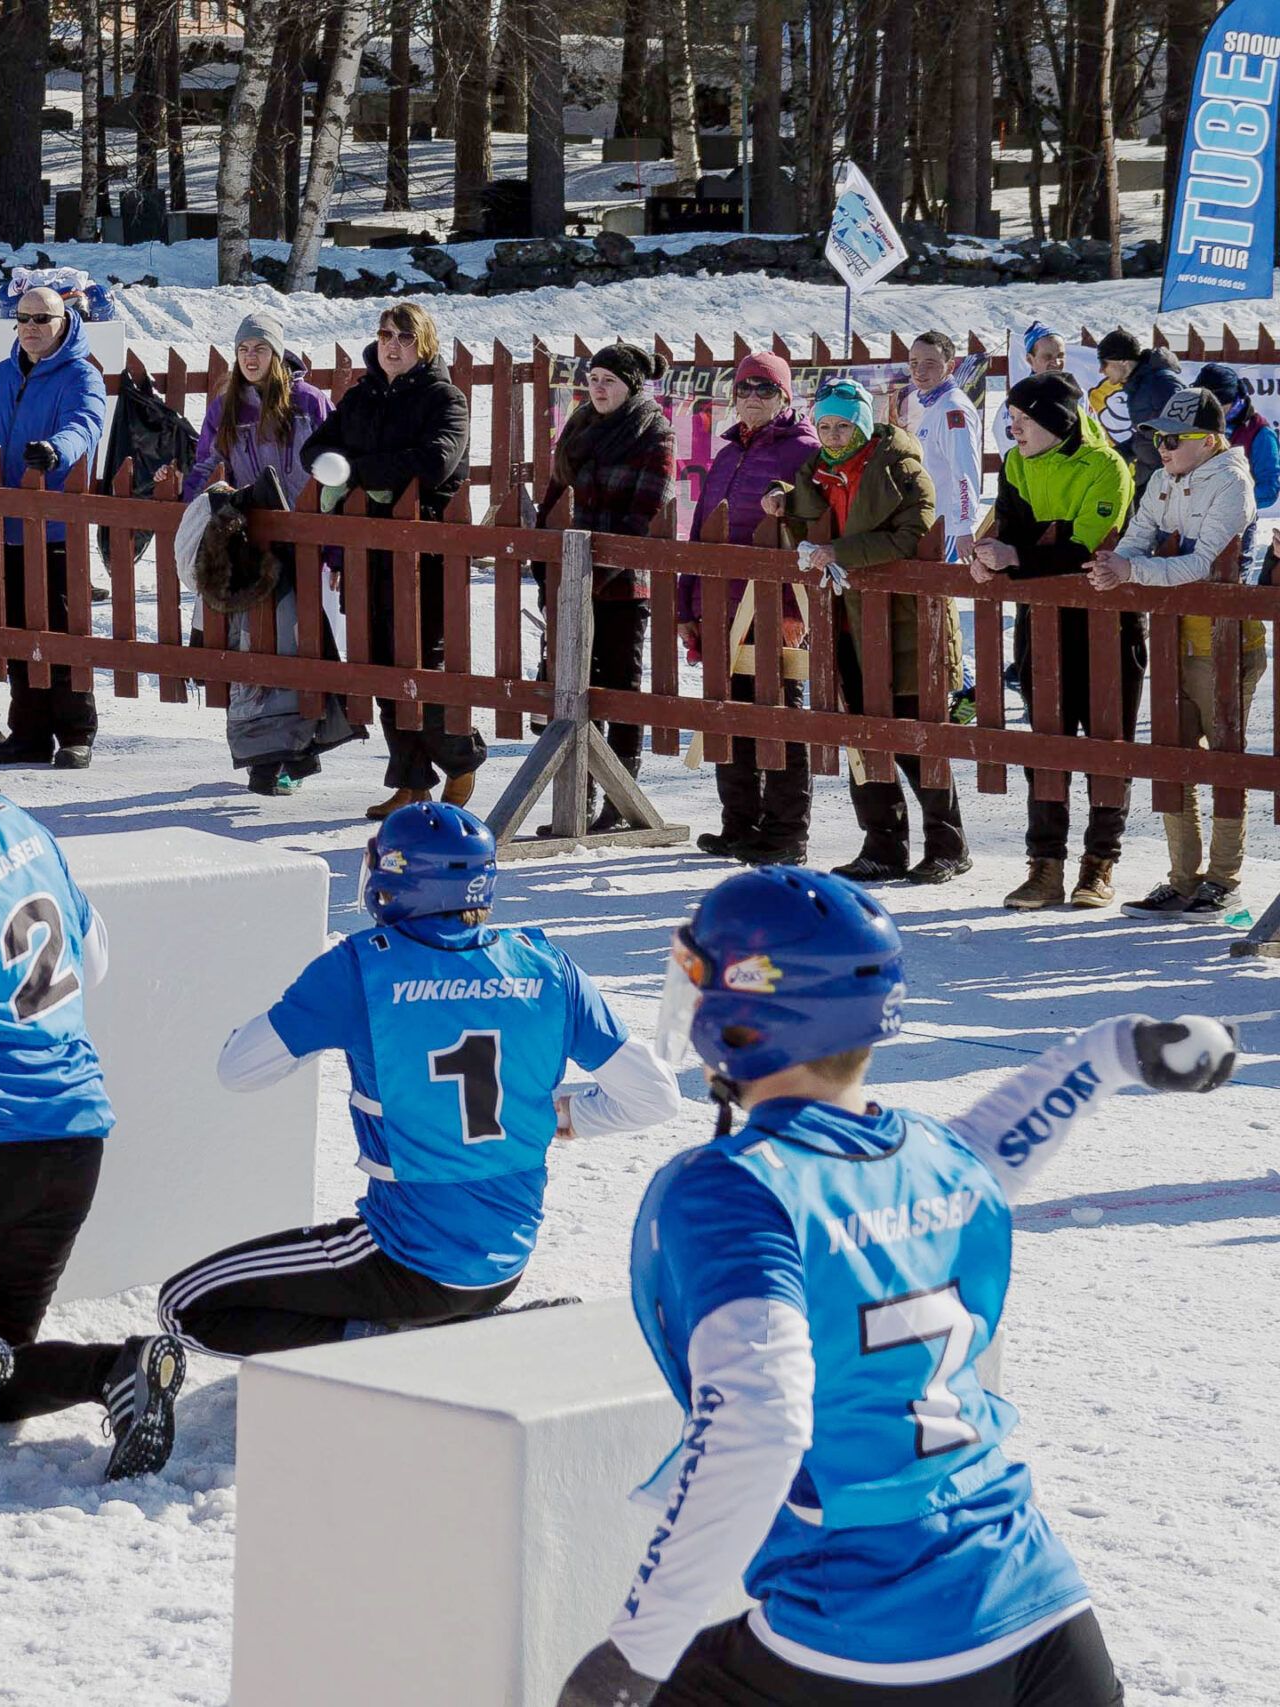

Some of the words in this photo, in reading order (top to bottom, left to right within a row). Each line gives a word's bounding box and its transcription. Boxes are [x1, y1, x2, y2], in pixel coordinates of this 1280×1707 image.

[1224, 31, 1280, 59] SNOW
[1177, 51, 1278, 254] TUBE
[1198, 245, 1249, 270] TOUR
[0, 891, 82, 1023] 2
[369, 933, 391, 951] 1
[392, 977, 543, 1004] YUKIGASSEN
[427, 1028, 507, 1145] 1
[858, 1277, 982, 1459] 7
